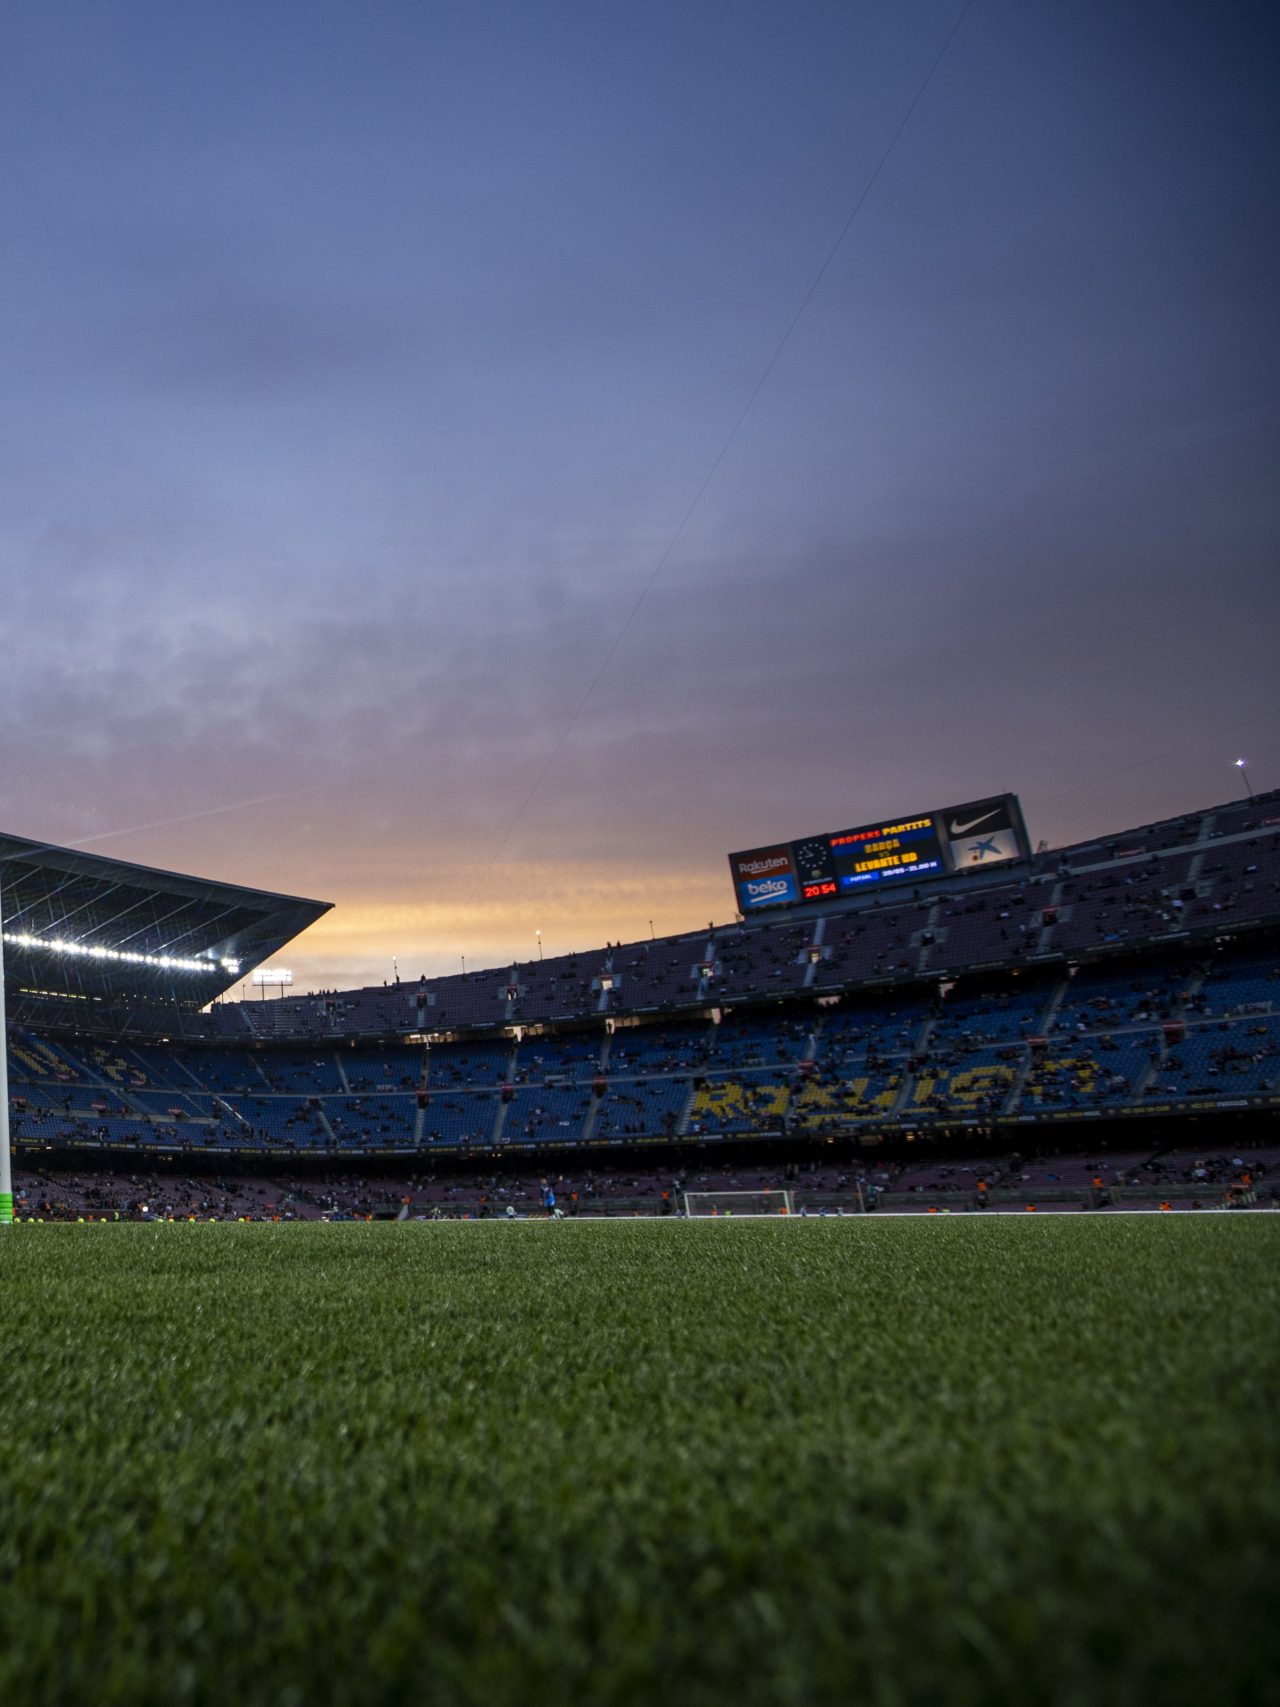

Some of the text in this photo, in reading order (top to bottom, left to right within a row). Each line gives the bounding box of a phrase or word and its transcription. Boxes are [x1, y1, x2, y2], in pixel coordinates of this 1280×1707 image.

[830, 818, 932, 847] PROPERS PARTITS
[738, 857, 789, 873] Rakuten
[854, 856, 901, 873] LEVANTE
[747, 880, 788, 895] beko
